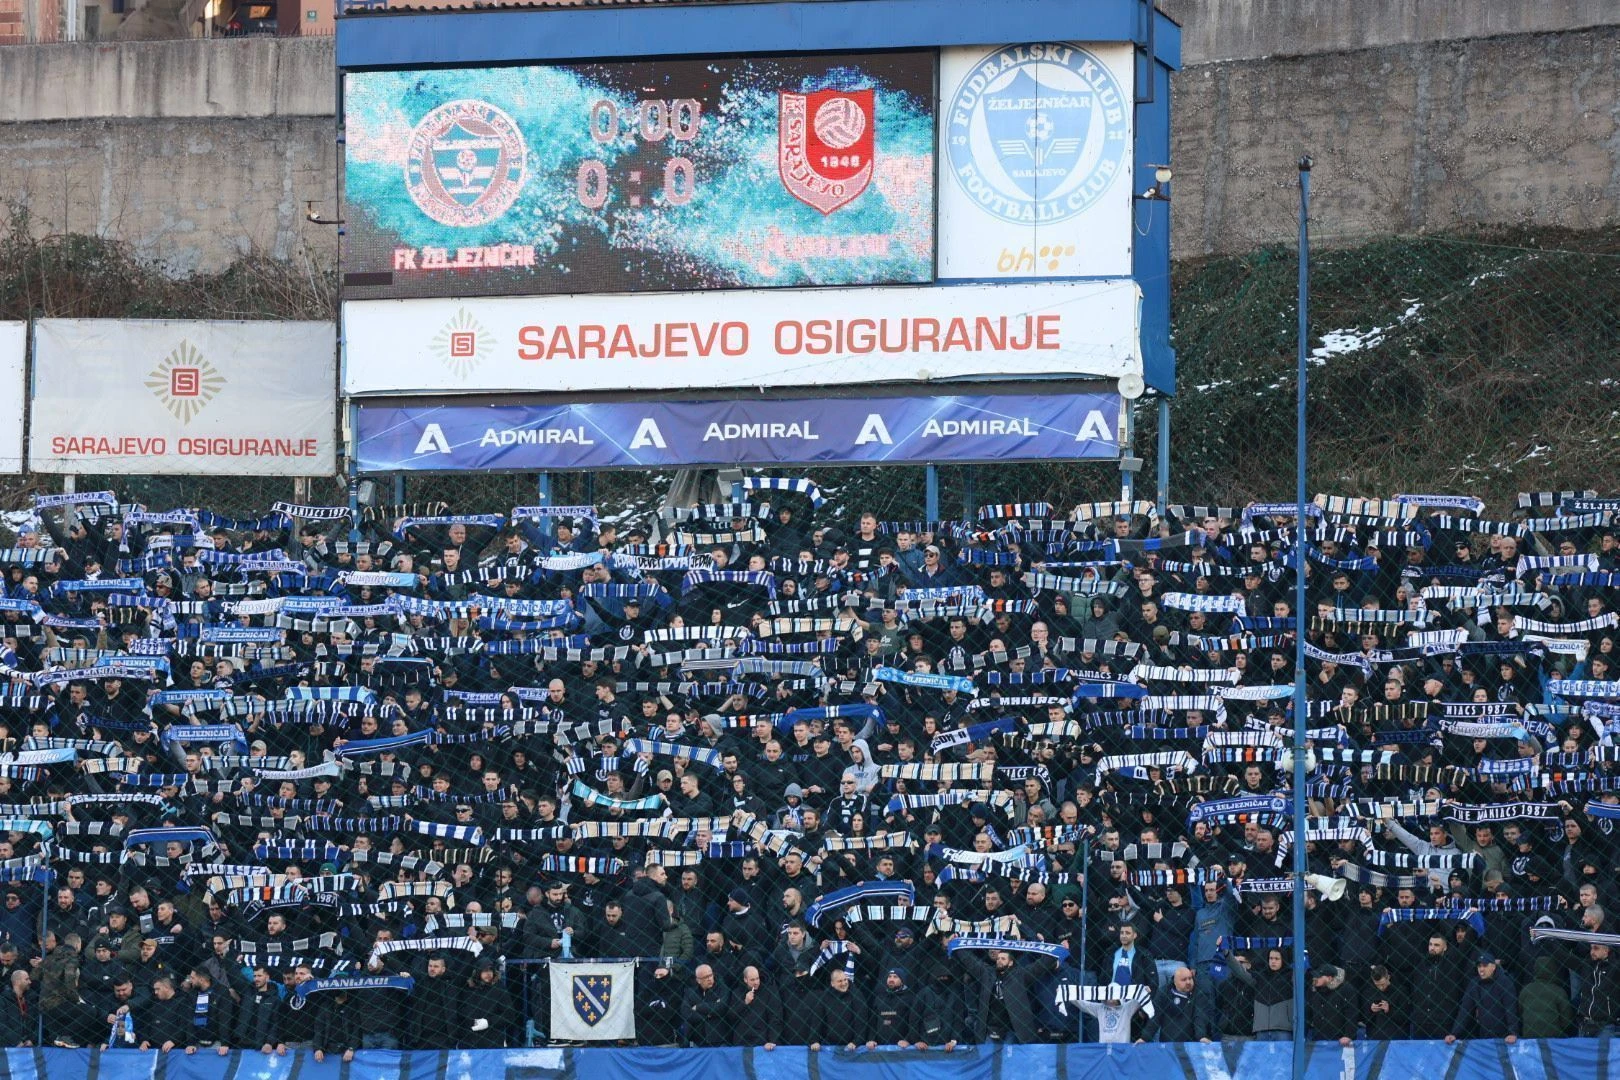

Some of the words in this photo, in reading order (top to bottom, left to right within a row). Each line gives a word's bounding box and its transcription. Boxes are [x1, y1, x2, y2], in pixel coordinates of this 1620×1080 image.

[953, 43, 1073, 127] FUDBALSKI
[1080, 59, 1124, 126] KLUB
[988, 95, 1092, 111] ŽELJEZNIČAR
[952, 135, 967, 146] 19
[1013, 168, 1067, 177] SARAJEVO
[958, 162, 1065, 222] FOOTBALL
[1066, 158, 1117, 209] CLUB
[518, 320, 748, 360] SARAJEVO
[774, 314, 1061, 356] OSIGURANJE
[479, 425, 594, 447] ADMIRAL
[703, 420, 819, 441] ADMIRAL
[922, 416, 1039, 438] ADMIRAL
[51, 437, 166, 456] SARAJEVO
[177, 438, 317, 458] OSIGURANJE
[286, 504, 325, 517] MANIACS
[328, 506, 350, 517] 1987
[1574, 500, 1620, 510] ŽELJEZ
[664, 557, 688, 569] DVA
[691, 554, 713, 568] JEDAN
[1550, 642, 1581, 650] JEZNIČA
[1446, 705, 1476, 716] NIACS
[1482, 704, 1508, 715] 1987
[1204, 804, 1216, 813] FK
[1453, 808, 1471, 821] THE
[1477, 806, 1517, 821] MANIACS
[1521, 804, 1548, 818] 1987
